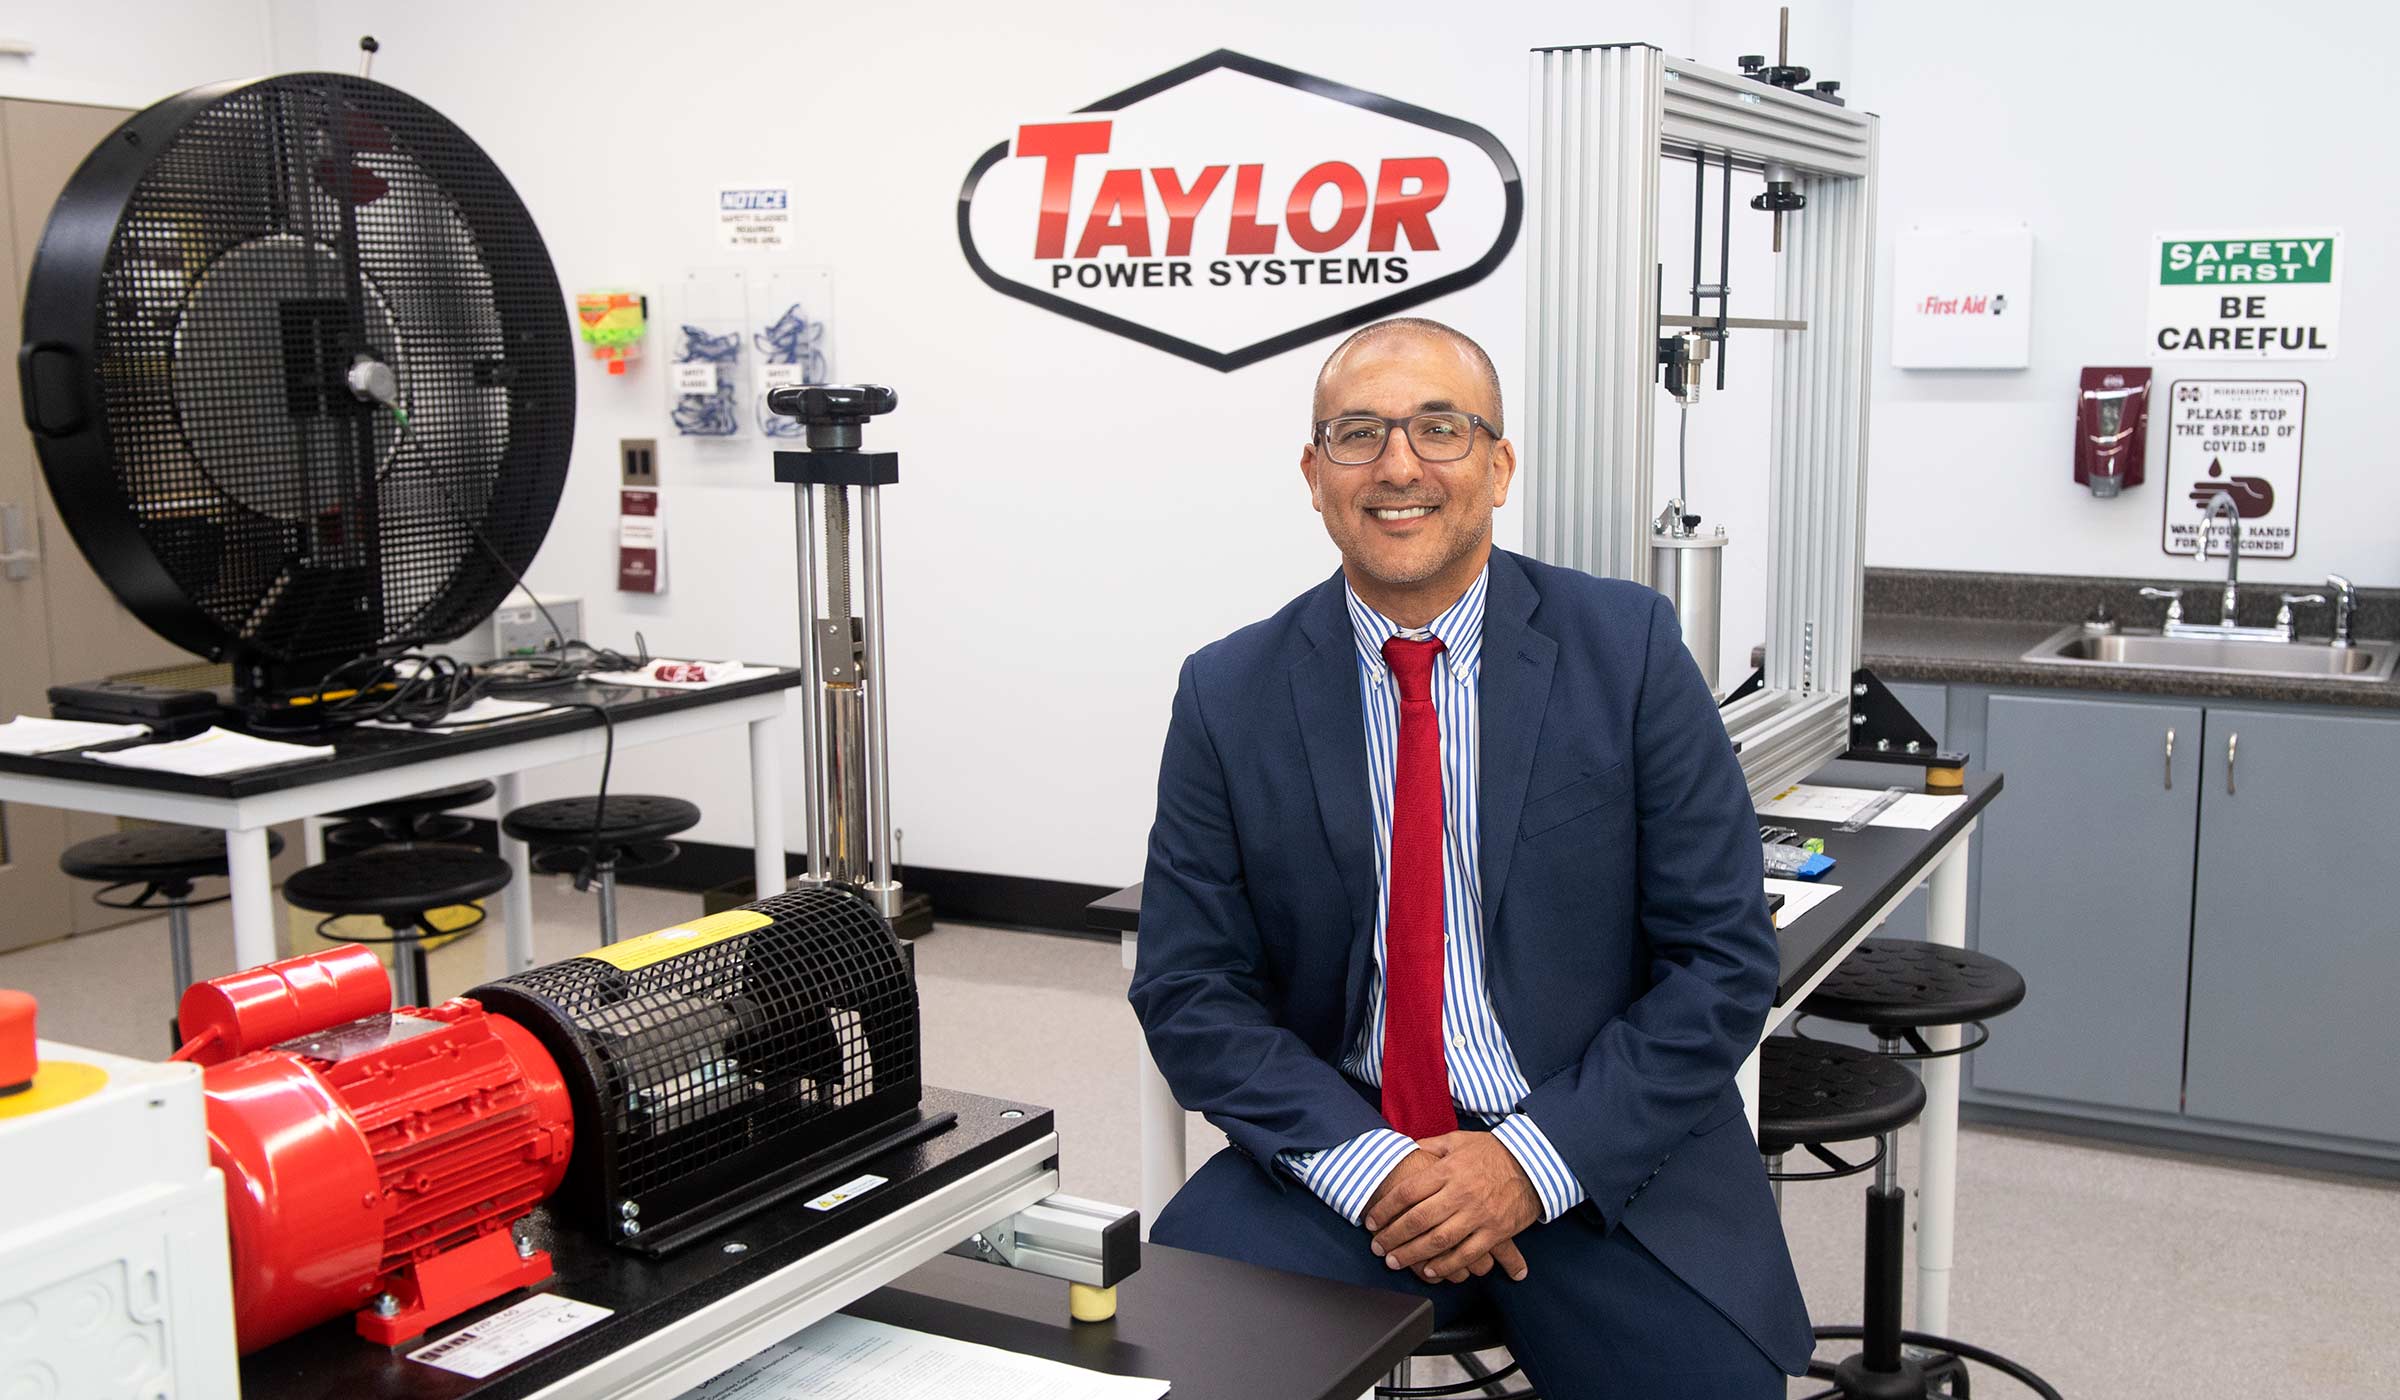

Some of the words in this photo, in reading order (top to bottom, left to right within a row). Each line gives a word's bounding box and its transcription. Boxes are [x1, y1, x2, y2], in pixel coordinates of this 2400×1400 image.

[1016, 120, 1449, 259] TAYLOR
[721, 191, 785, 209] NOTICE
[2169, 241, 2325, 271] SAFETY
[1052, 262, 1194, 288] POWER
[1208, 257, 1410, 287] SYSTEMS
[2195, 263, 2302, 282] FIRST
[1924, 296, 1958, 315] First
[1961, 295, 1988, 314] Aid
[2220, 296, 2266, 319] BE
[2157, 327, 2327, 350] CAREFUL
[2187, 409, 2242, 420] PLEASE
[2250, 409, 2288, 421] STOP
[2176, 425, 2205, 436] THE
[2212, 425, 2269, 437] SPREAD
[2277, 425, 2295, 437] OF
[2250, 526, 2291, 537] HANDS
[2225, 540, 2285, 551] SCONDS!
